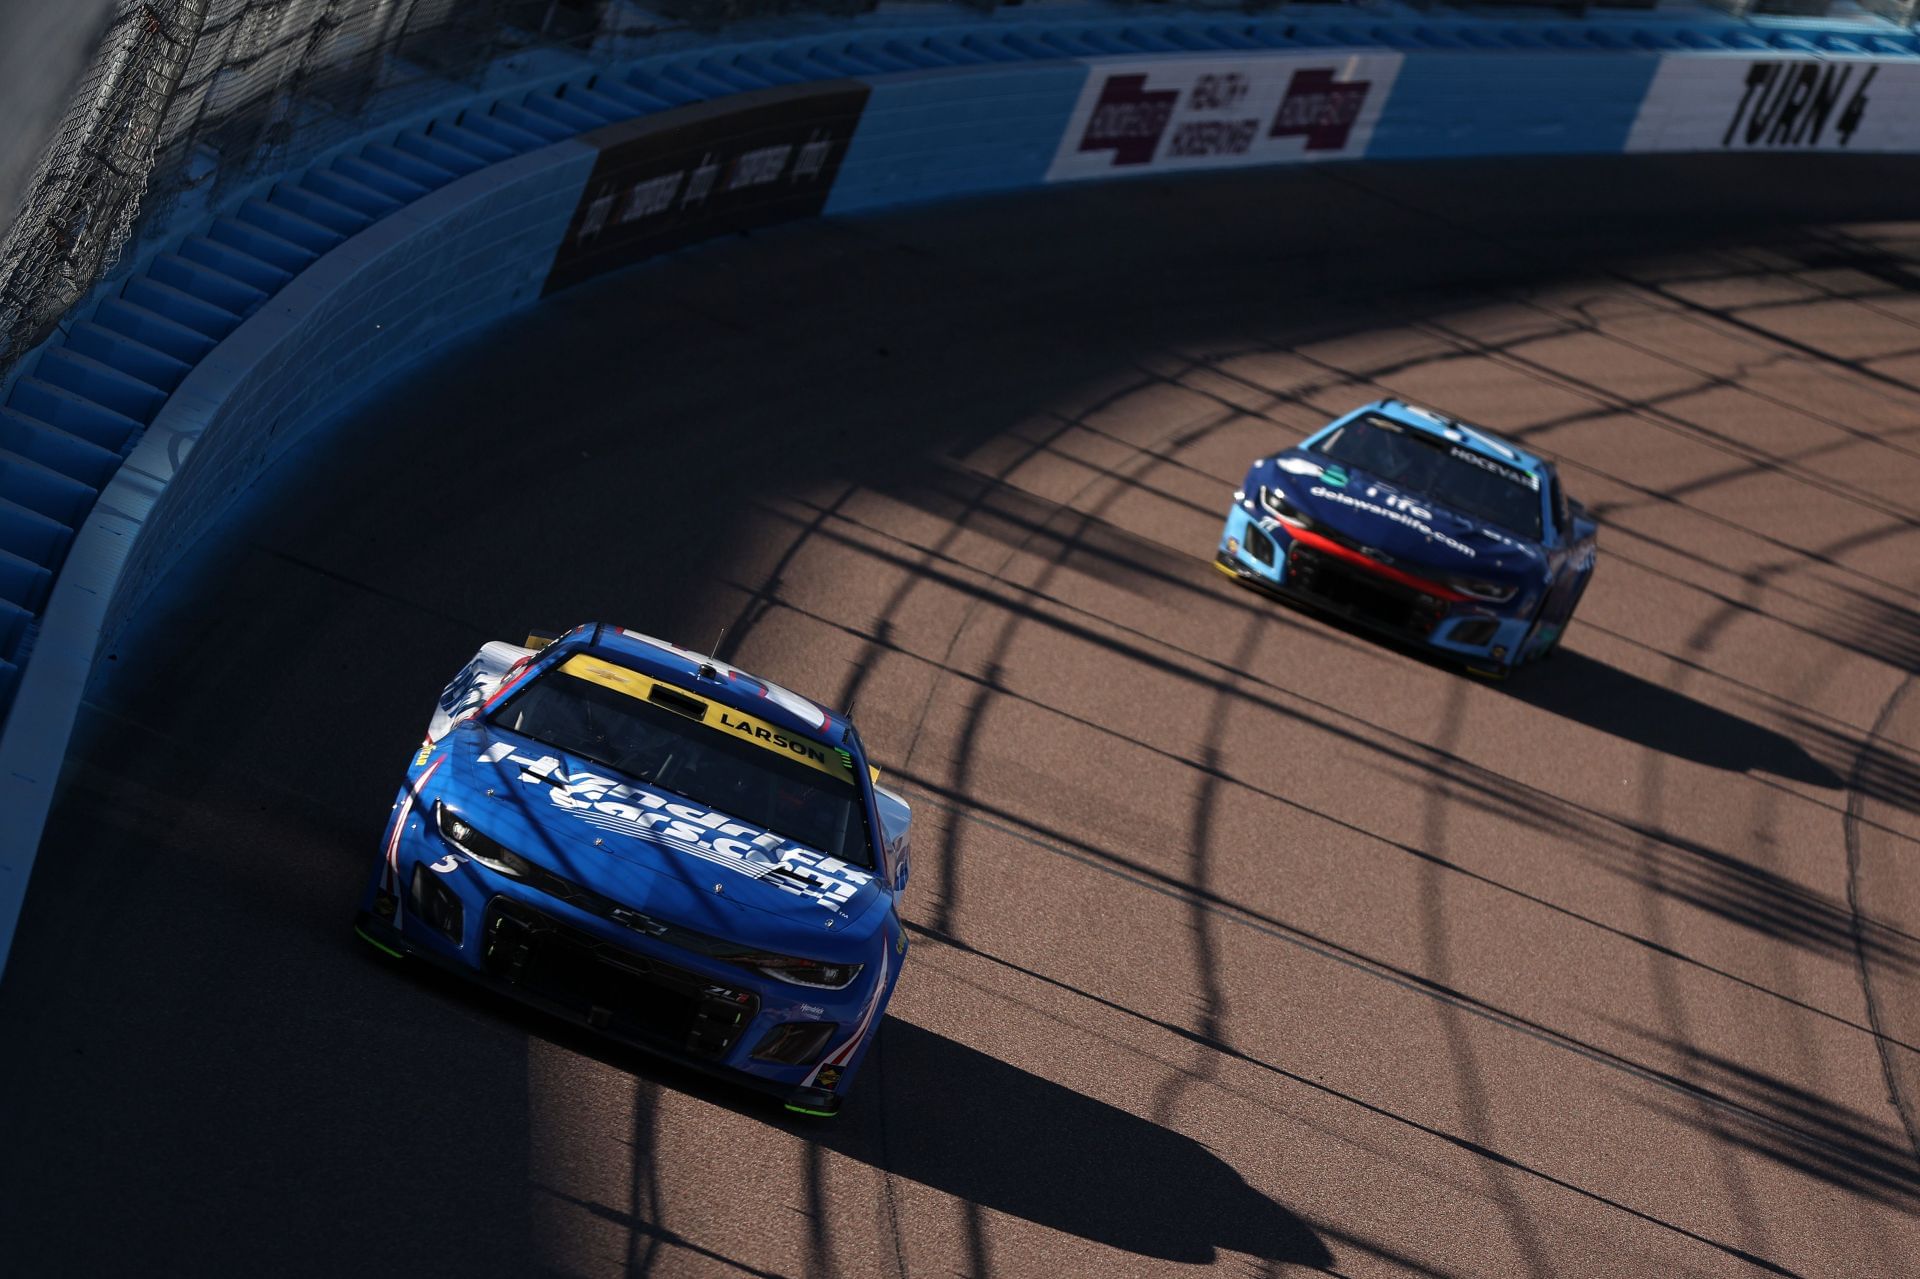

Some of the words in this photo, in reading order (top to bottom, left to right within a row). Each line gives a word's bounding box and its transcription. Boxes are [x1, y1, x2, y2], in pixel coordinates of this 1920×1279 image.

[1722, 62, 1853, 146] TURN
[720, 713, 825, 765] LARSON
[429, 854, 469, 874] 5
